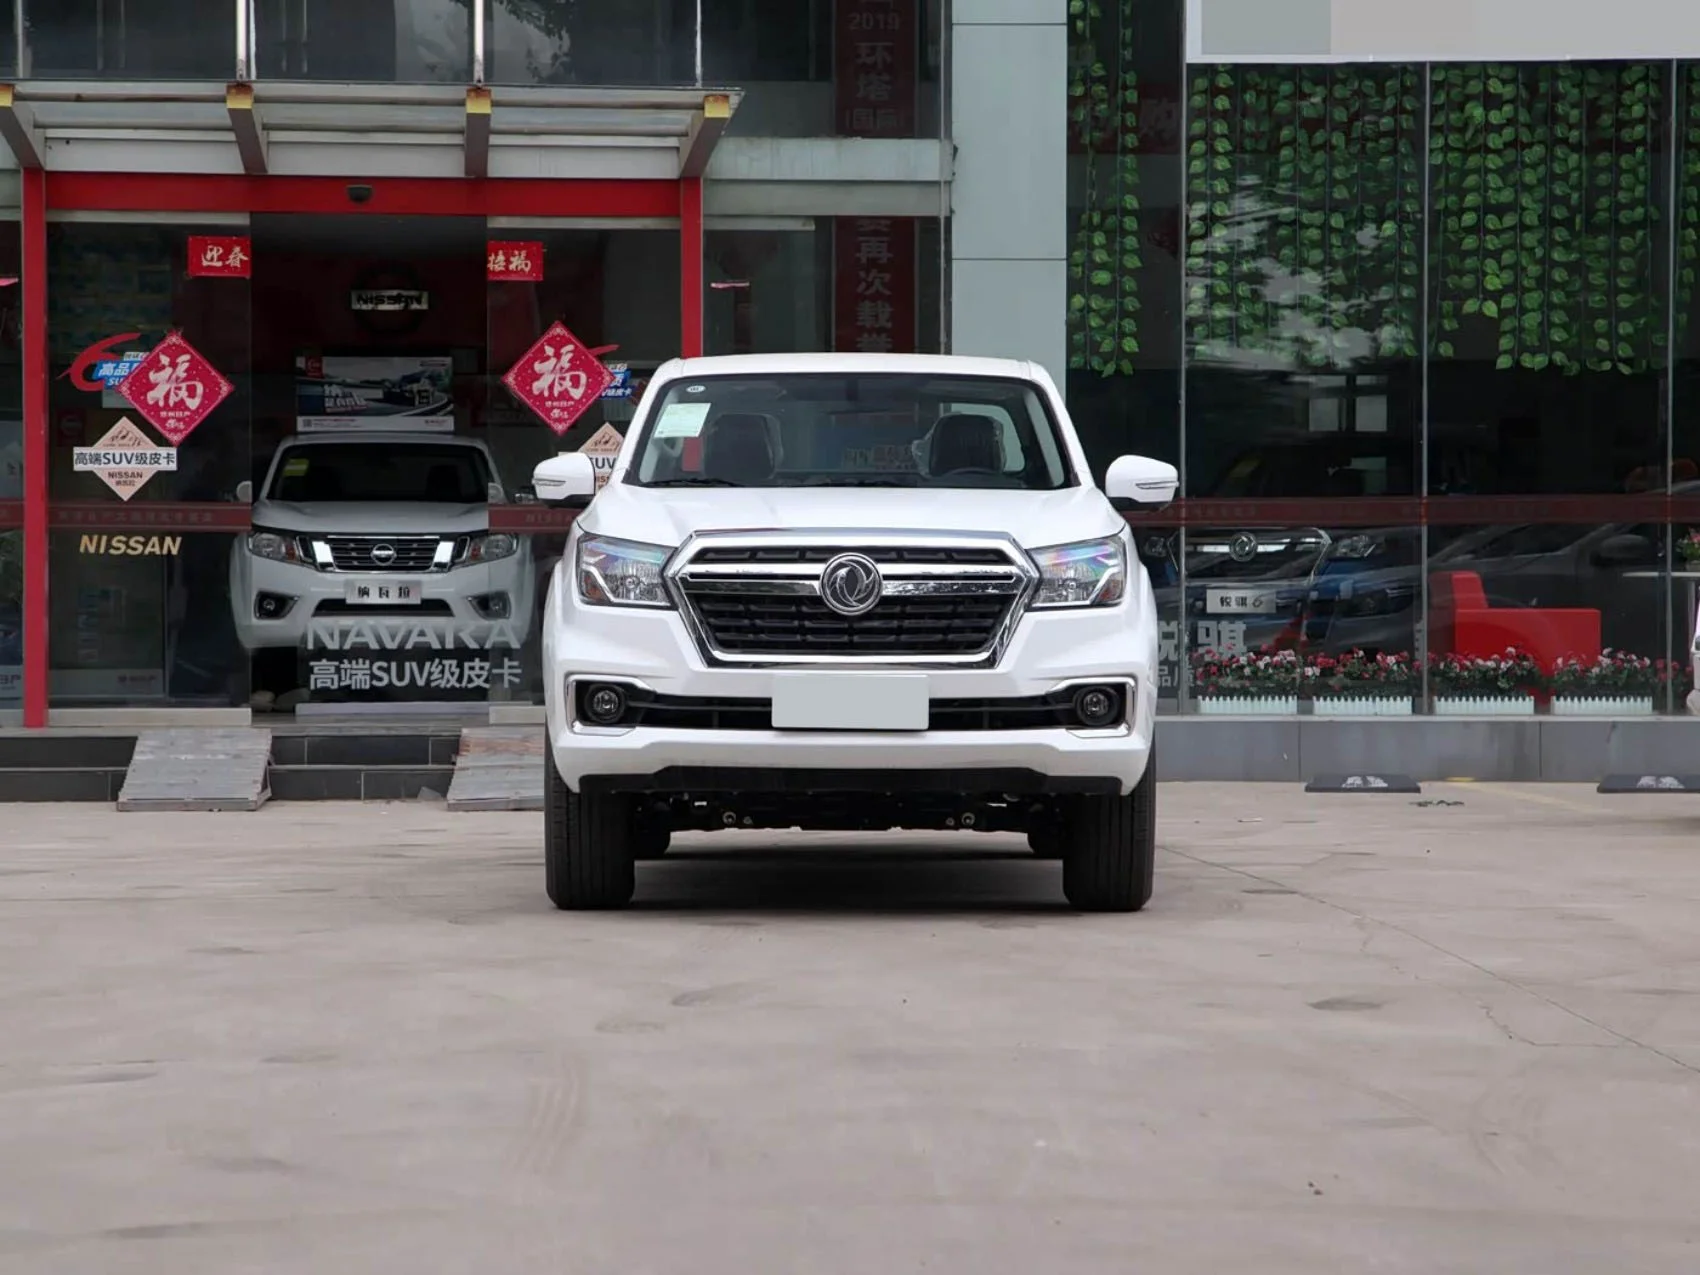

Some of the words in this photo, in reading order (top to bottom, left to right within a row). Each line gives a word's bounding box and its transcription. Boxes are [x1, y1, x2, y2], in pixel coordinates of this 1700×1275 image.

[201, 244, 249, 268] 迎春
[356, 292, 423, 305] NISSAN
[147, 352, 204, 410] 福
[532, 344, 587, 399] 福
[74, 452, 176, 466] 高端SUV级皮卡
[107, 471, 143, 479] NISSAN
[79, 534, 182, 556] NISSAN
[306, 621, 522, 650] NAVARA
[309, 657, 523, 690] 高端SUV级皮卡
